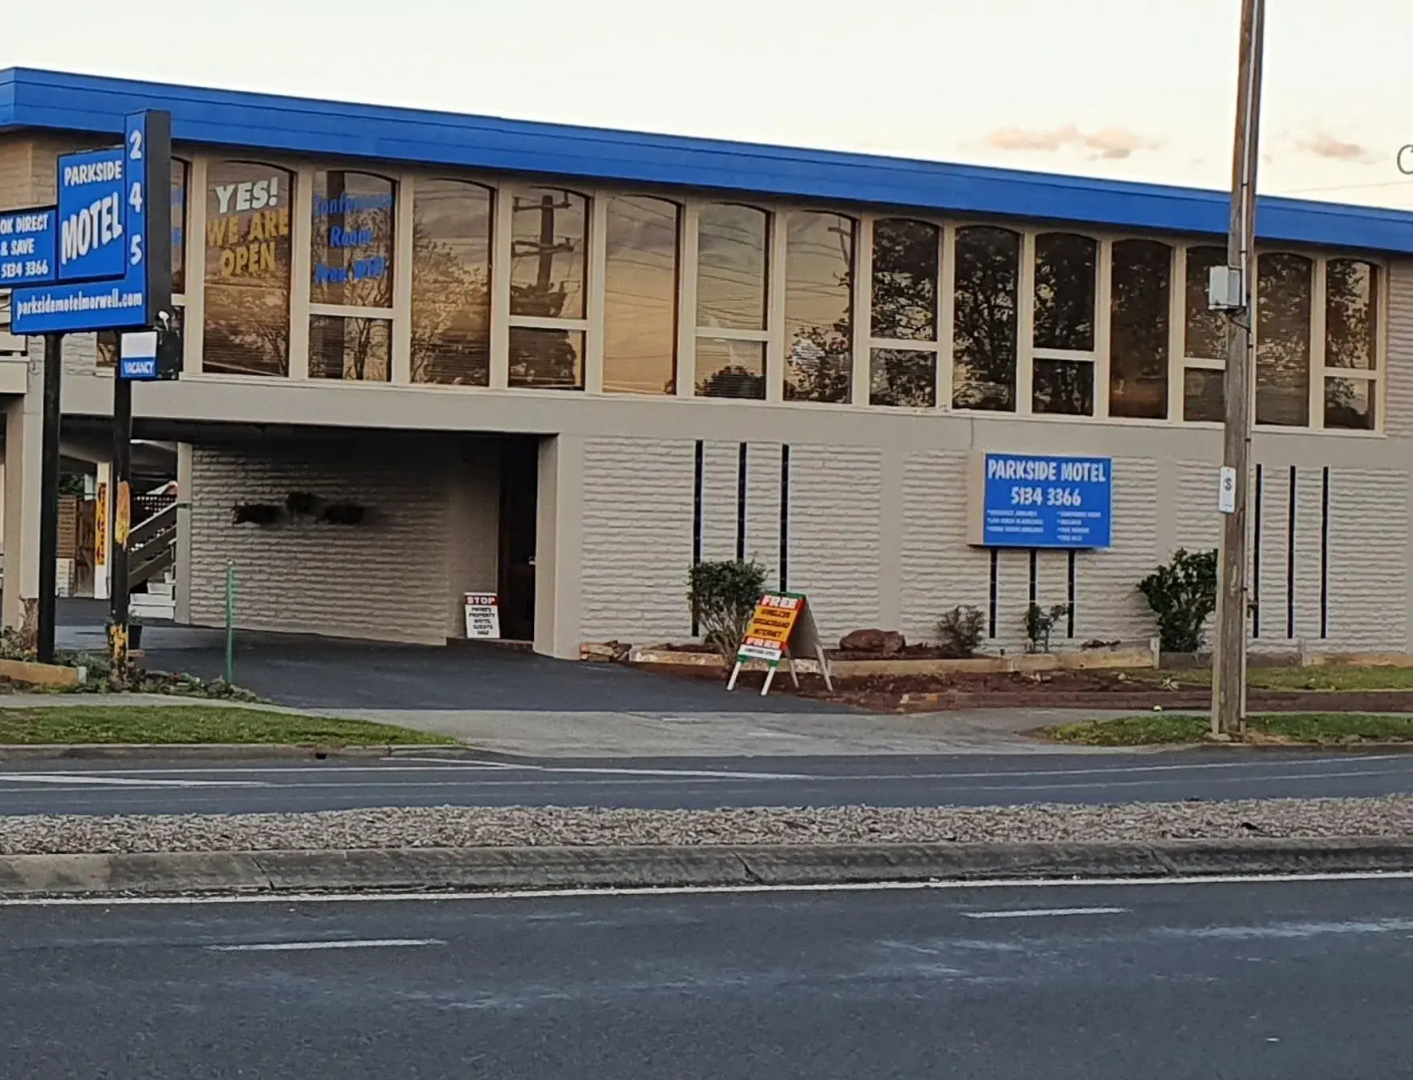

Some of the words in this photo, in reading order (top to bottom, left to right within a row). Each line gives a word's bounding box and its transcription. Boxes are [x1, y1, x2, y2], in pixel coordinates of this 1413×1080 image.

[64, 160, 122, 187] PARKSIDE
[215, 176, 278, 214] YES!
[15, 213, 49, 233] DIRECT
[61, 191, 123, 265] MOTEL
[206, 216, 238, 246] WE
[249, 207, 289, 242] ARE
[0, 241, 8, 256] &
[10, 238, 35, 256] SAVE
[1, 262, 22, 278] 5134
[25, 259, 48, 276] 3366
[220, 241, 276, 277] OPEN
[16, 288, 143, 320] parksidemotelmorwell.com
[123, 361, 155, 375] VACANCY
[988, 459, 1057, 481] PARKSIDE
[1060, 463, 1106, 482] MOTEL
[1011, 487, 1043, 506] 5134
[1047, 488, 1082, 506] 3366
[466, 596, 496, 604] STOP
